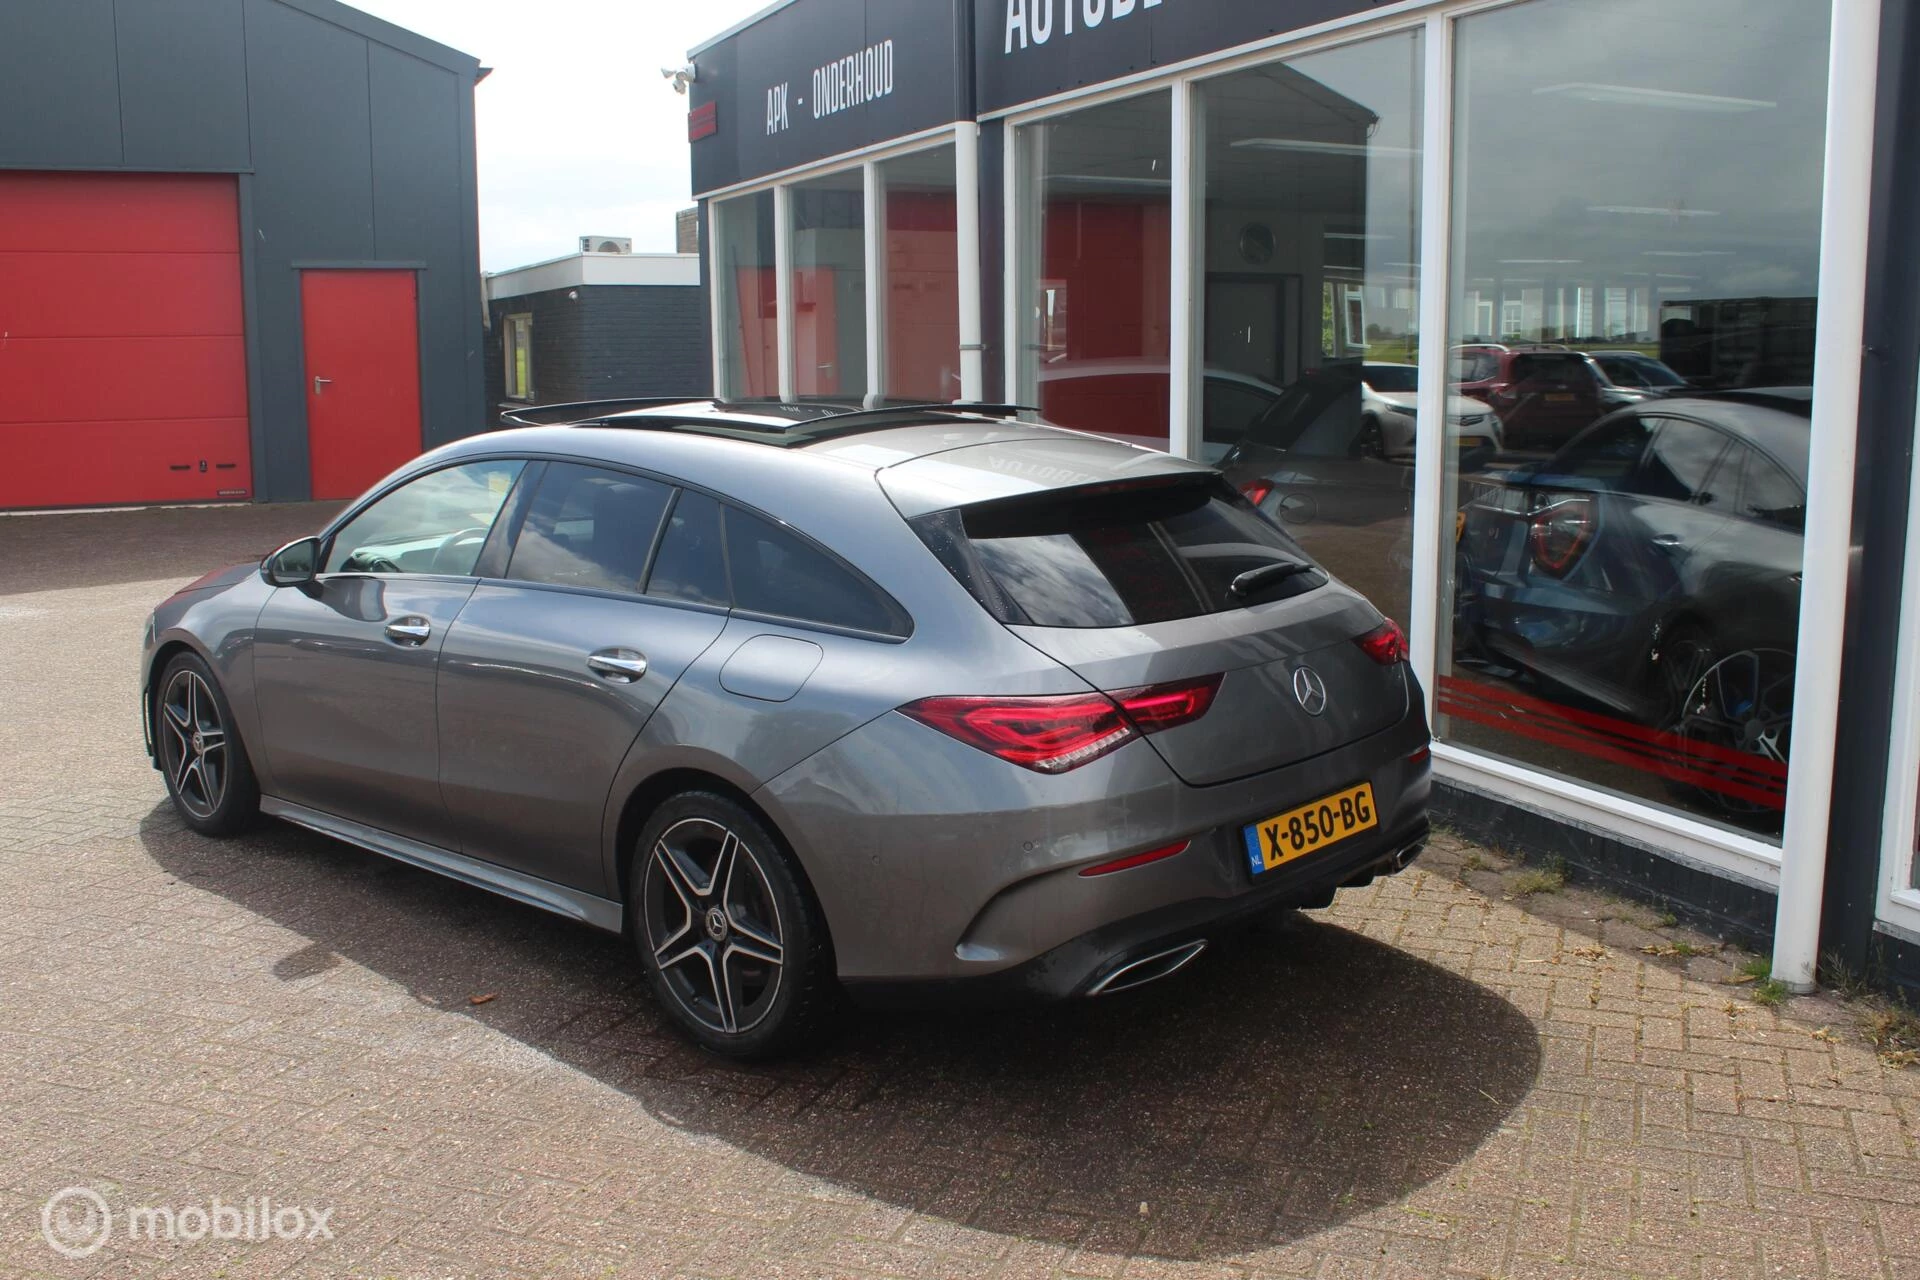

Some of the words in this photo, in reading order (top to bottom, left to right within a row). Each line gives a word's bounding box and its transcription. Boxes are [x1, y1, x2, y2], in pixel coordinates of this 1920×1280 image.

[766, 82, 789, 136] APK
[813, 39, 893, 120] ONDERHOUD
[1251, 855, 1263, 867] NL
[1264, 791, 1371, 861] X-850-BG
